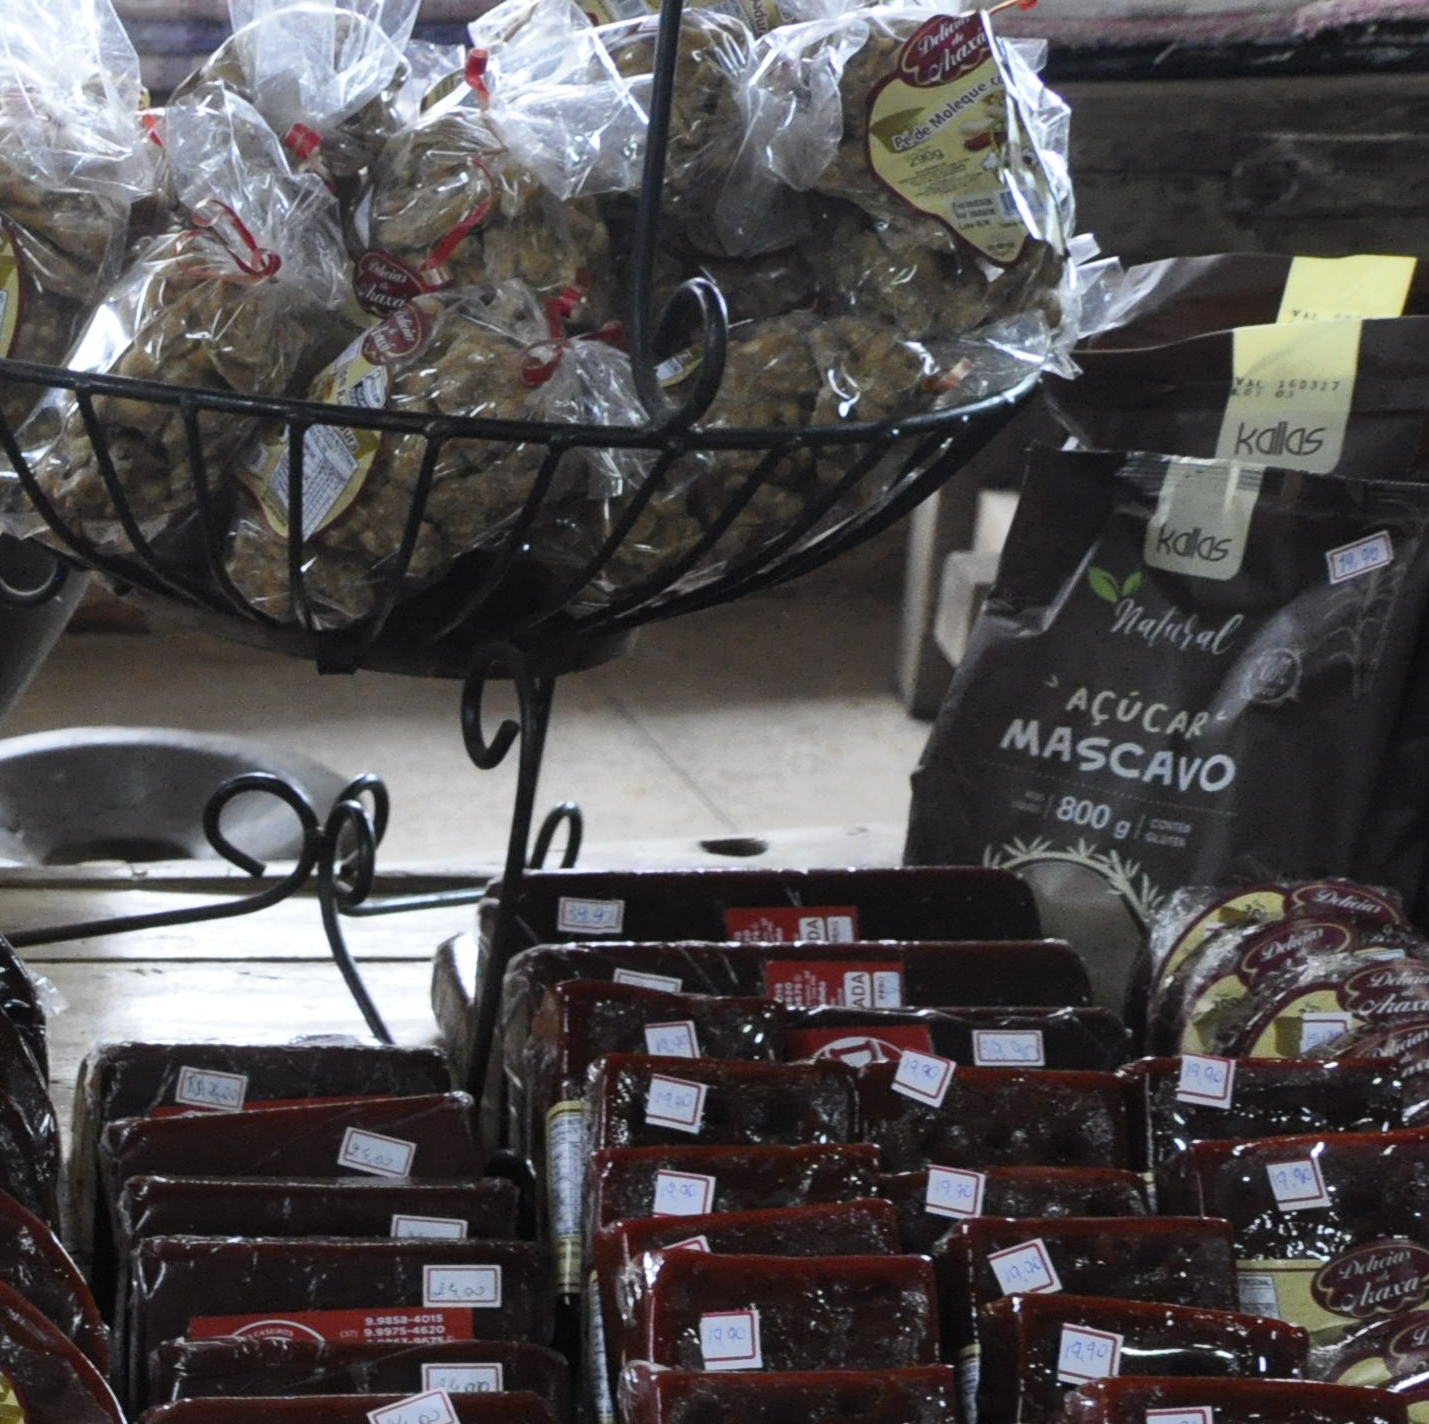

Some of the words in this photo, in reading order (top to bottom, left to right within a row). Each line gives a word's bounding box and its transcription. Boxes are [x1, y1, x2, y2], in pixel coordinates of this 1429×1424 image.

[915, 123, 932, 143] de
[929, 78, 987, 129] Moleque
[1235, 421, 1328, 457] kallas
[1156, 525, 1233, 562] kallas
[1110, 598, 1244, 655] Natural
[1065, 687, 1209, 739] AÇÚCAR
[1000, 718, 1236, 792] MASCAVO
[1056, 796, 1111, 829] 800
[1113, 820, 1131, 840] g
[363, 1325, 446, 1337] 9.9975-4620
